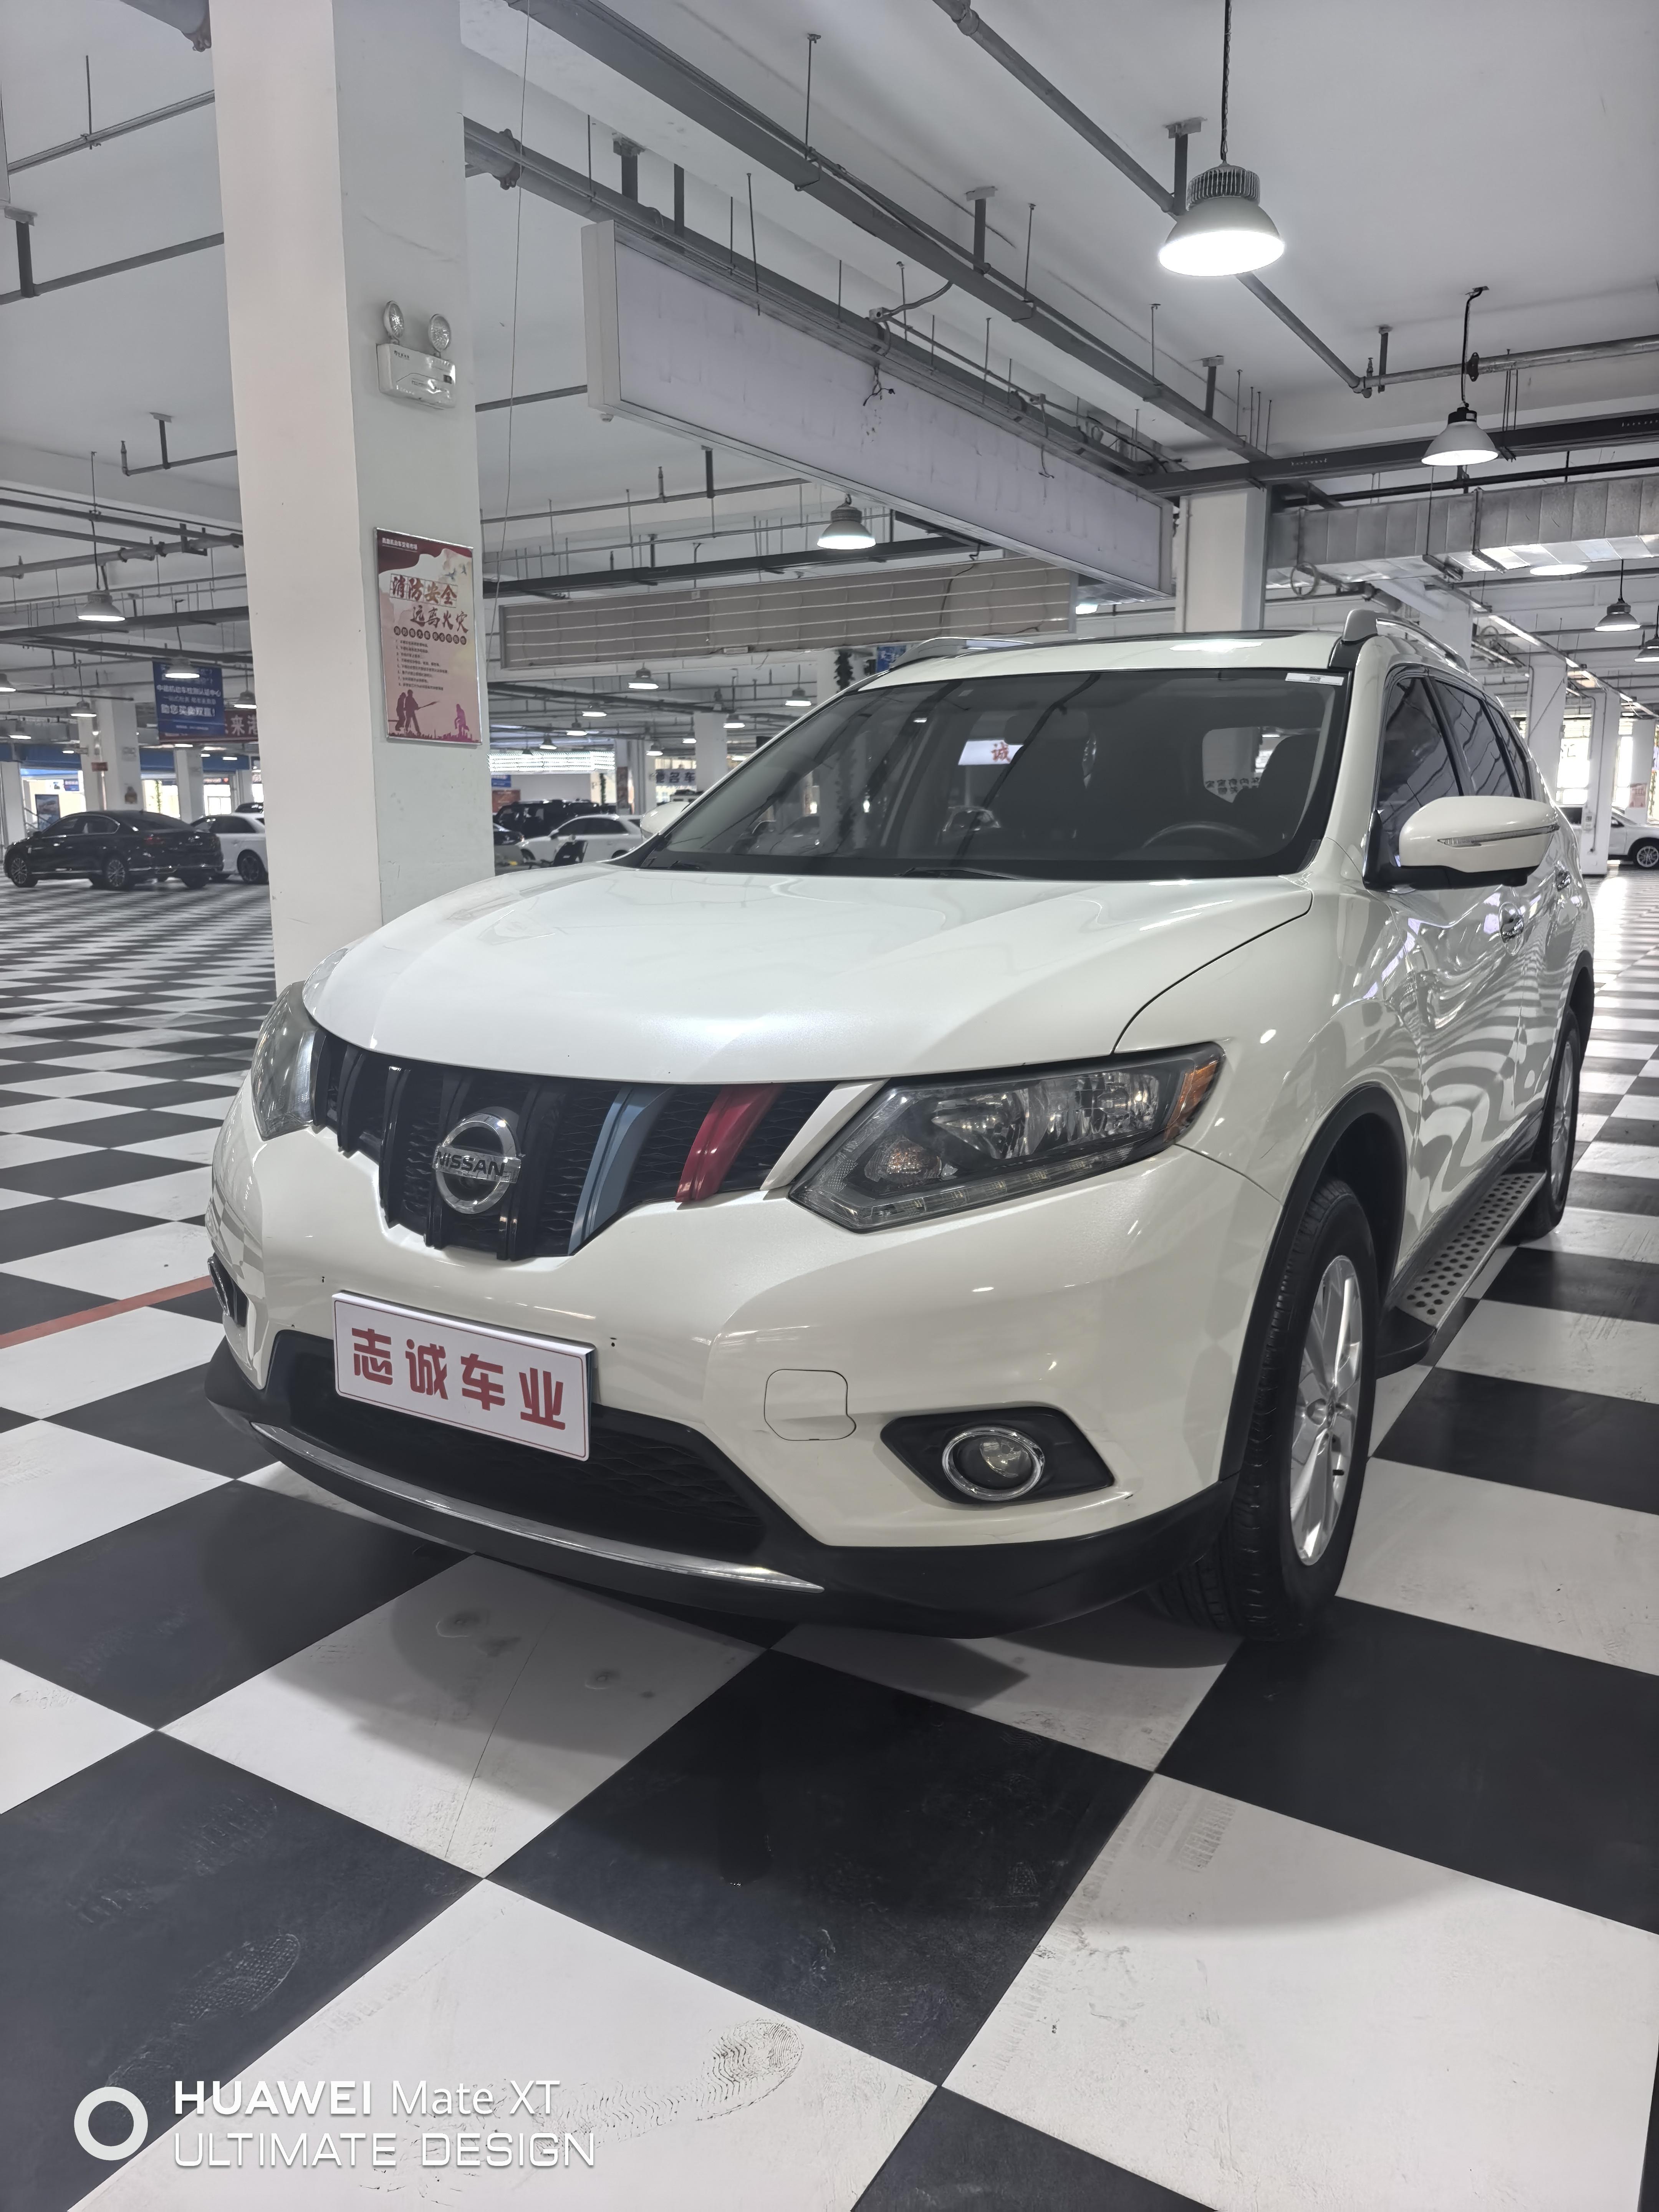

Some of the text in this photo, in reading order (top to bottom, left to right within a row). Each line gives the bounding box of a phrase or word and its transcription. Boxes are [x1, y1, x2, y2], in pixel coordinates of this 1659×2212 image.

[393, 574, 457, 605] 消防安全
[410, 604, 469, 633] 远离火灾
[991, 741, 1011, 762] 诚
[435, 1151, 505, 1177] NISSAN
[352, 1327, 566, 1431] 志诚车业
